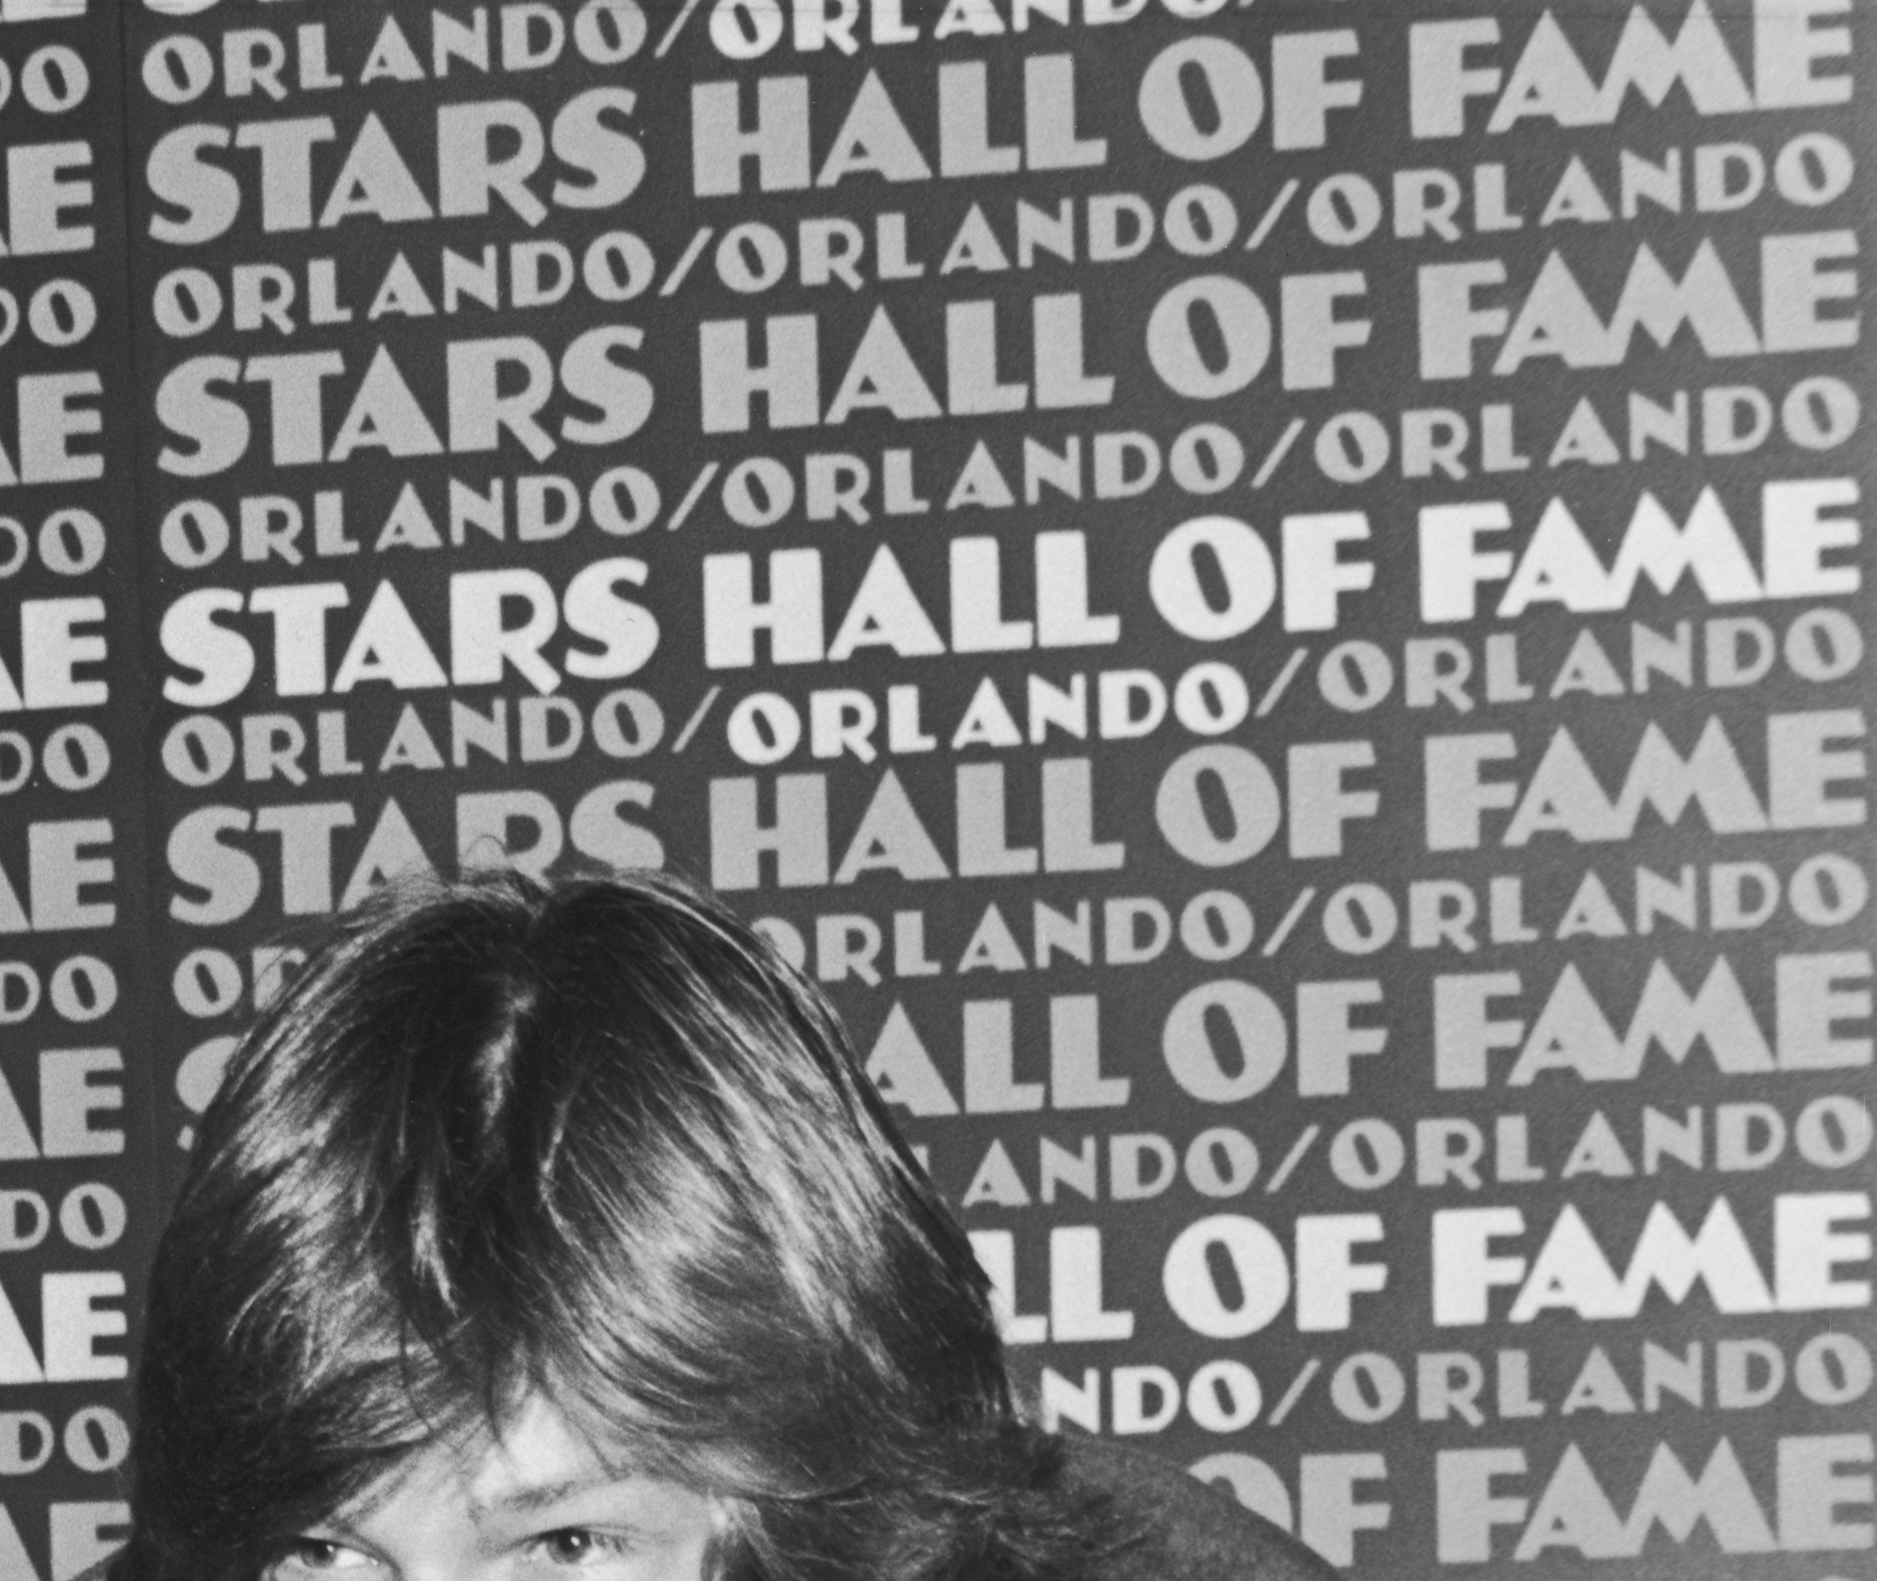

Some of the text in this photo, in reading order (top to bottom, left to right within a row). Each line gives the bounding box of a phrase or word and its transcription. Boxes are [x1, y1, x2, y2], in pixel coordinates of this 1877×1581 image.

[146, 0, 1852, 244] STARS HALL OF FAME
[156, 230, 1859, 477] STARS HALL OF FAME
[160, 478, 1860, 707] STARS HALL OF FAME
[710, 758, 1124, 891] HALL
[1156, 741, 1379, 866] OF
[1425, 710, 1865, 851] FAME
[865, 952, 1872, 1116] ALL OF FAME
[968, 1193, 1870, 1346] LL OF FAME
[1436, 1435, 1873, 1563] FAME
